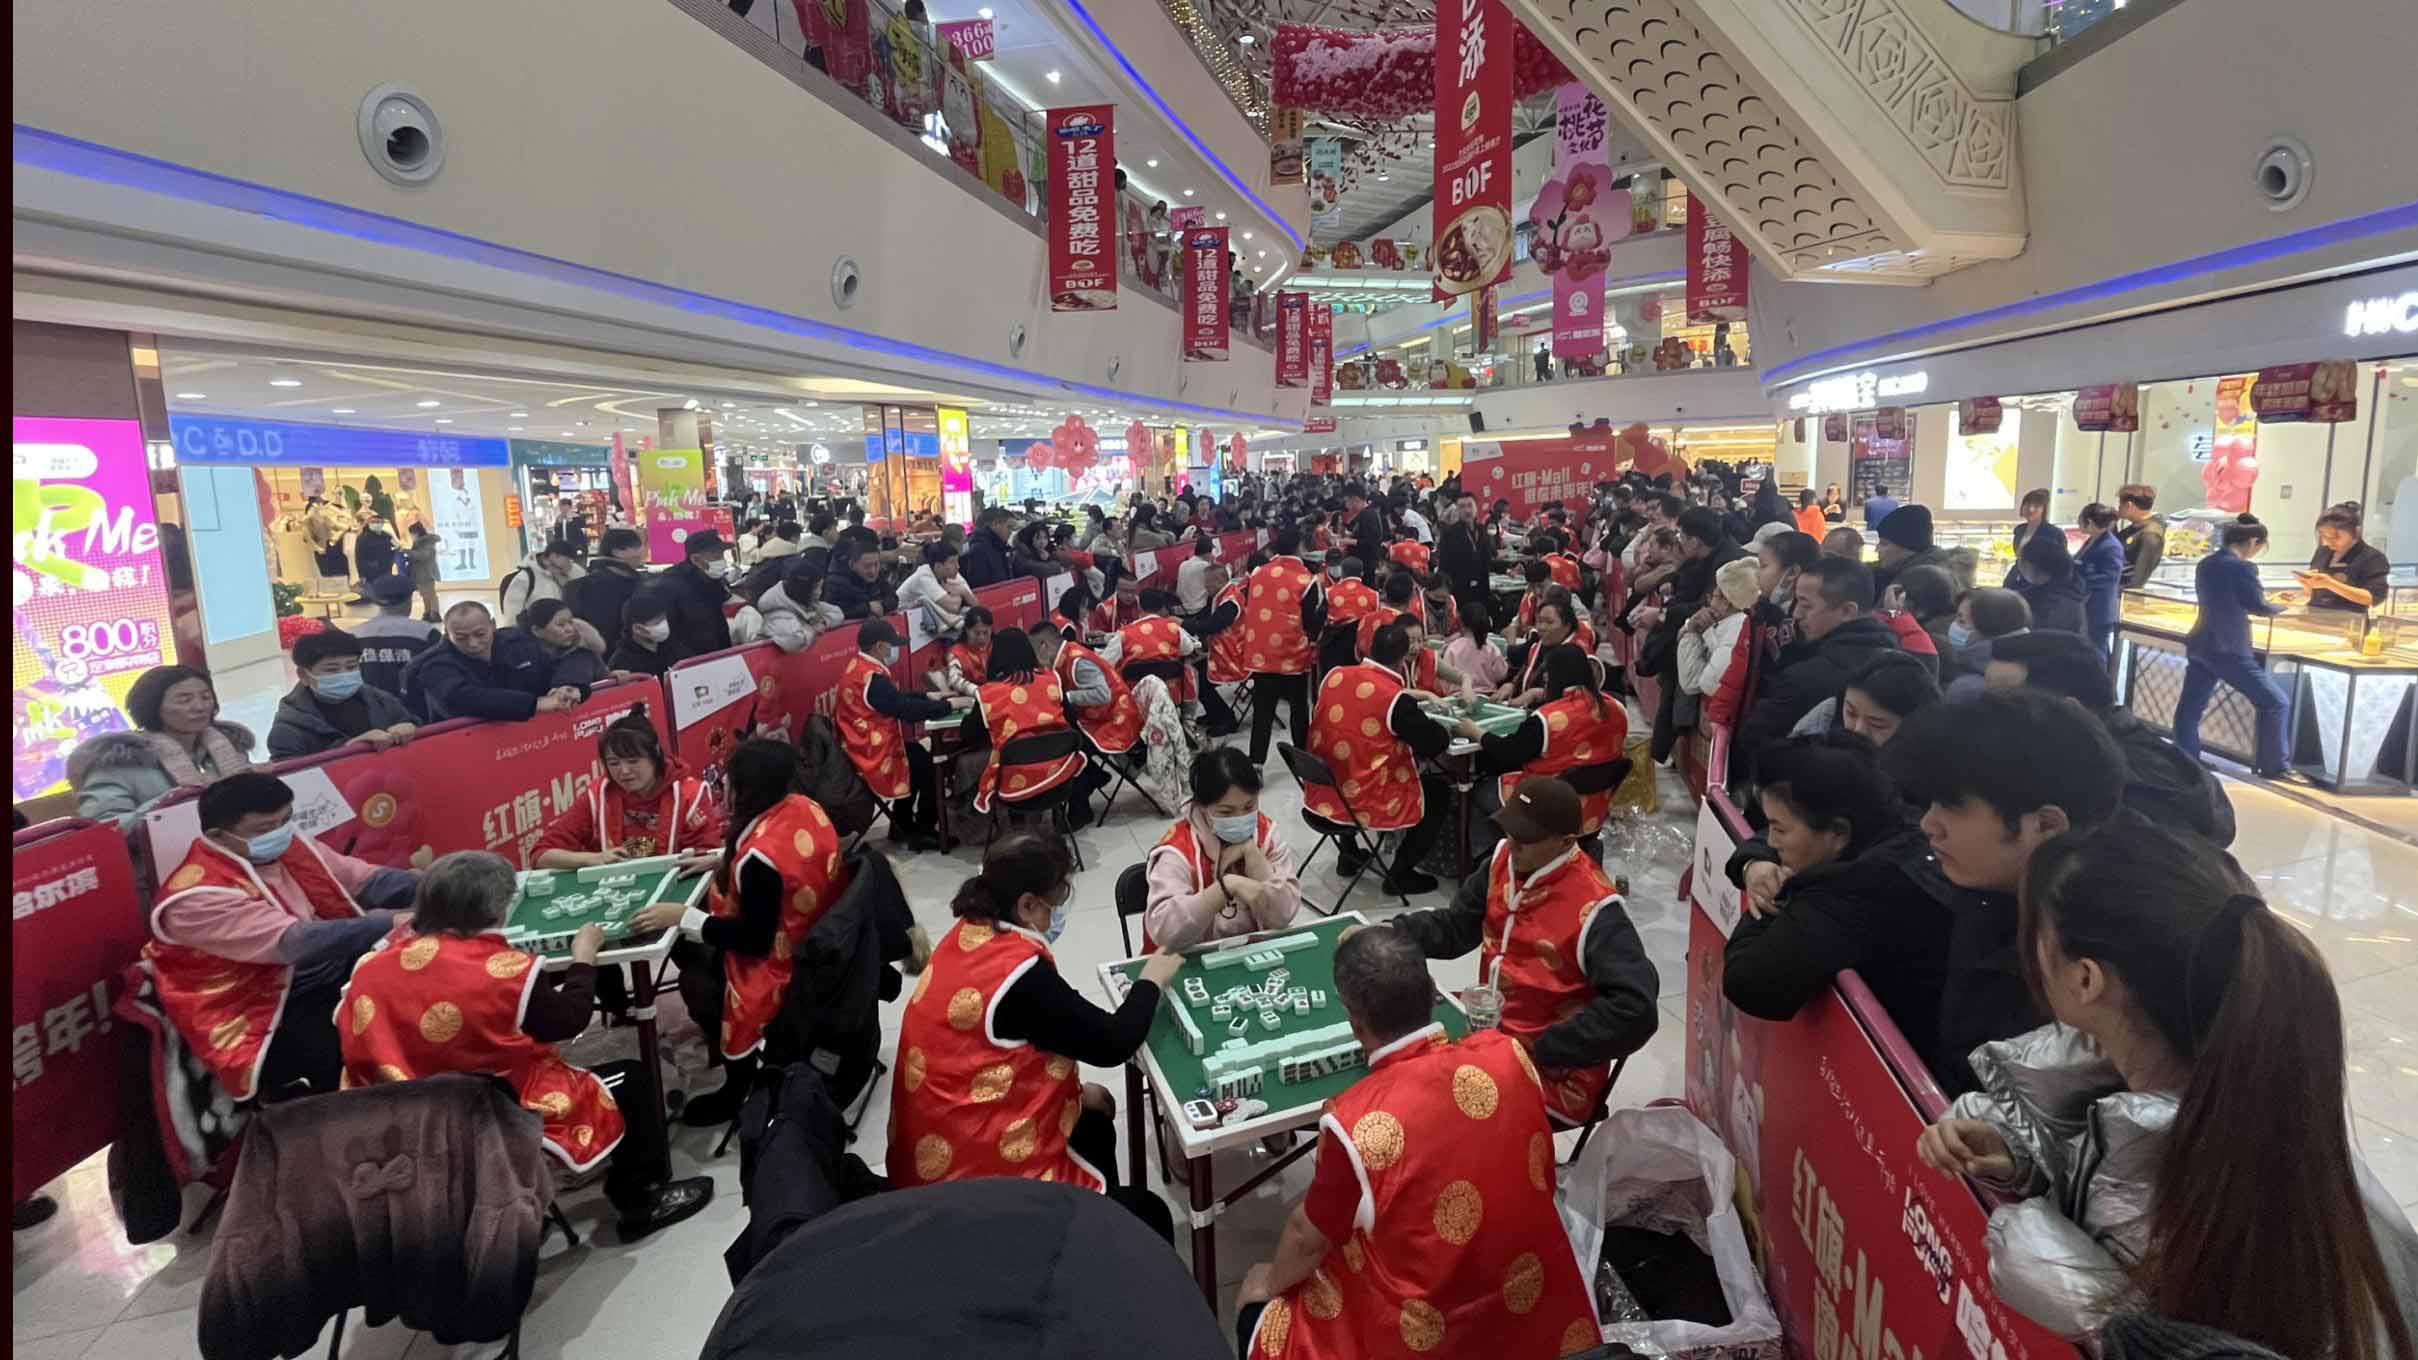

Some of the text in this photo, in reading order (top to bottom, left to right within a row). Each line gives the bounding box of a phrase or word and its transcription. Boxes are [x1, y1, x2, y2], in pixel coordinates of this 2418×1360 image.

[963, 35, 993, 59] 100
[1061, 139, 1101, 256] 12道甜品免费吃
[1452, 159, 1492, 206] BOF
[1065, 277, 1105, 289] BOF
[84, 505, 160, 557] Me
[62, 617, 140, 659] 800
